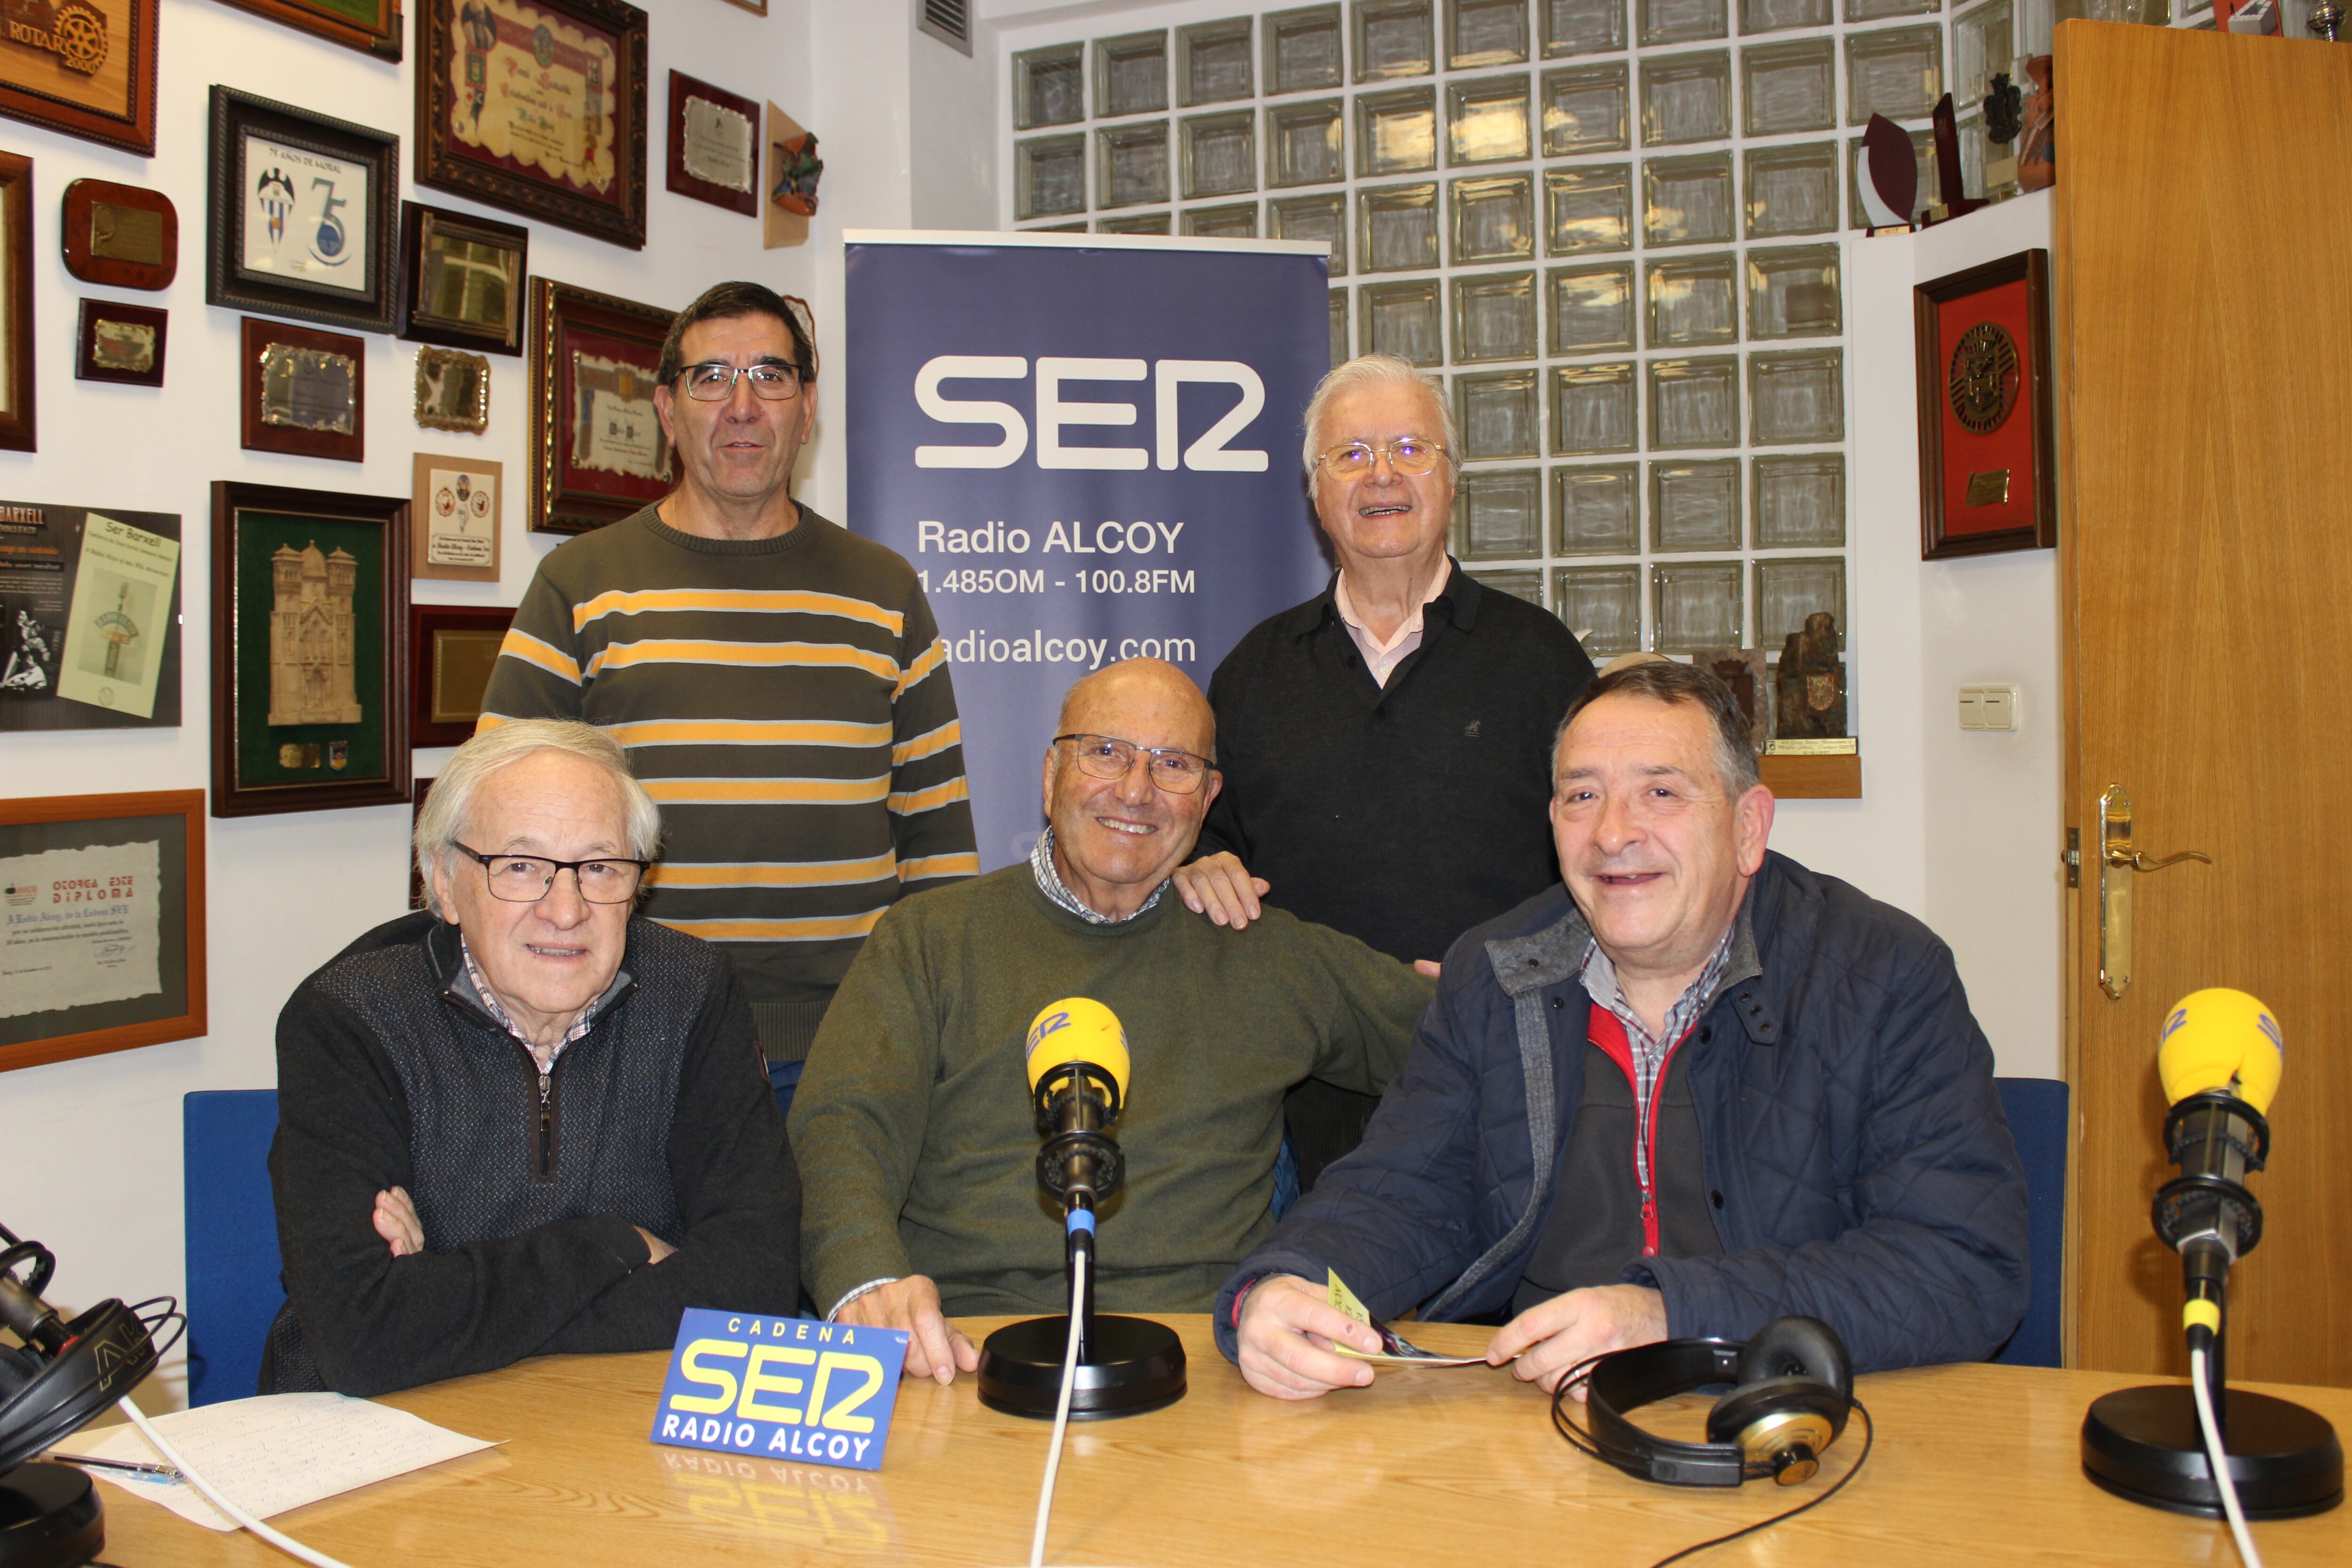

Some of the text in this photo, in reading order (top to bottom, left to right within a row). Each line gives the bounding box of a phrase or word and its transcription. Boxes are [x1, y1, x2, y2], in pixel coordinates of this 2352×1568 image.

[914, 355, 1269, 472] SER
[105, 521, 123, 535] Ser
[918, 521, 1184, 554] Radio ALCOY
[1075, 569, 1195, 594] 100.8FM
[941, 629, 1196, 670] adioalcoy.com
[53, 875, 134, 891] OTORGA ESTE
[728, 1317, 855, 1345] CADENA
[669, 1338, 884, 1434] SER
[662, 1414, 871, 1462] RADIO ALCOY
